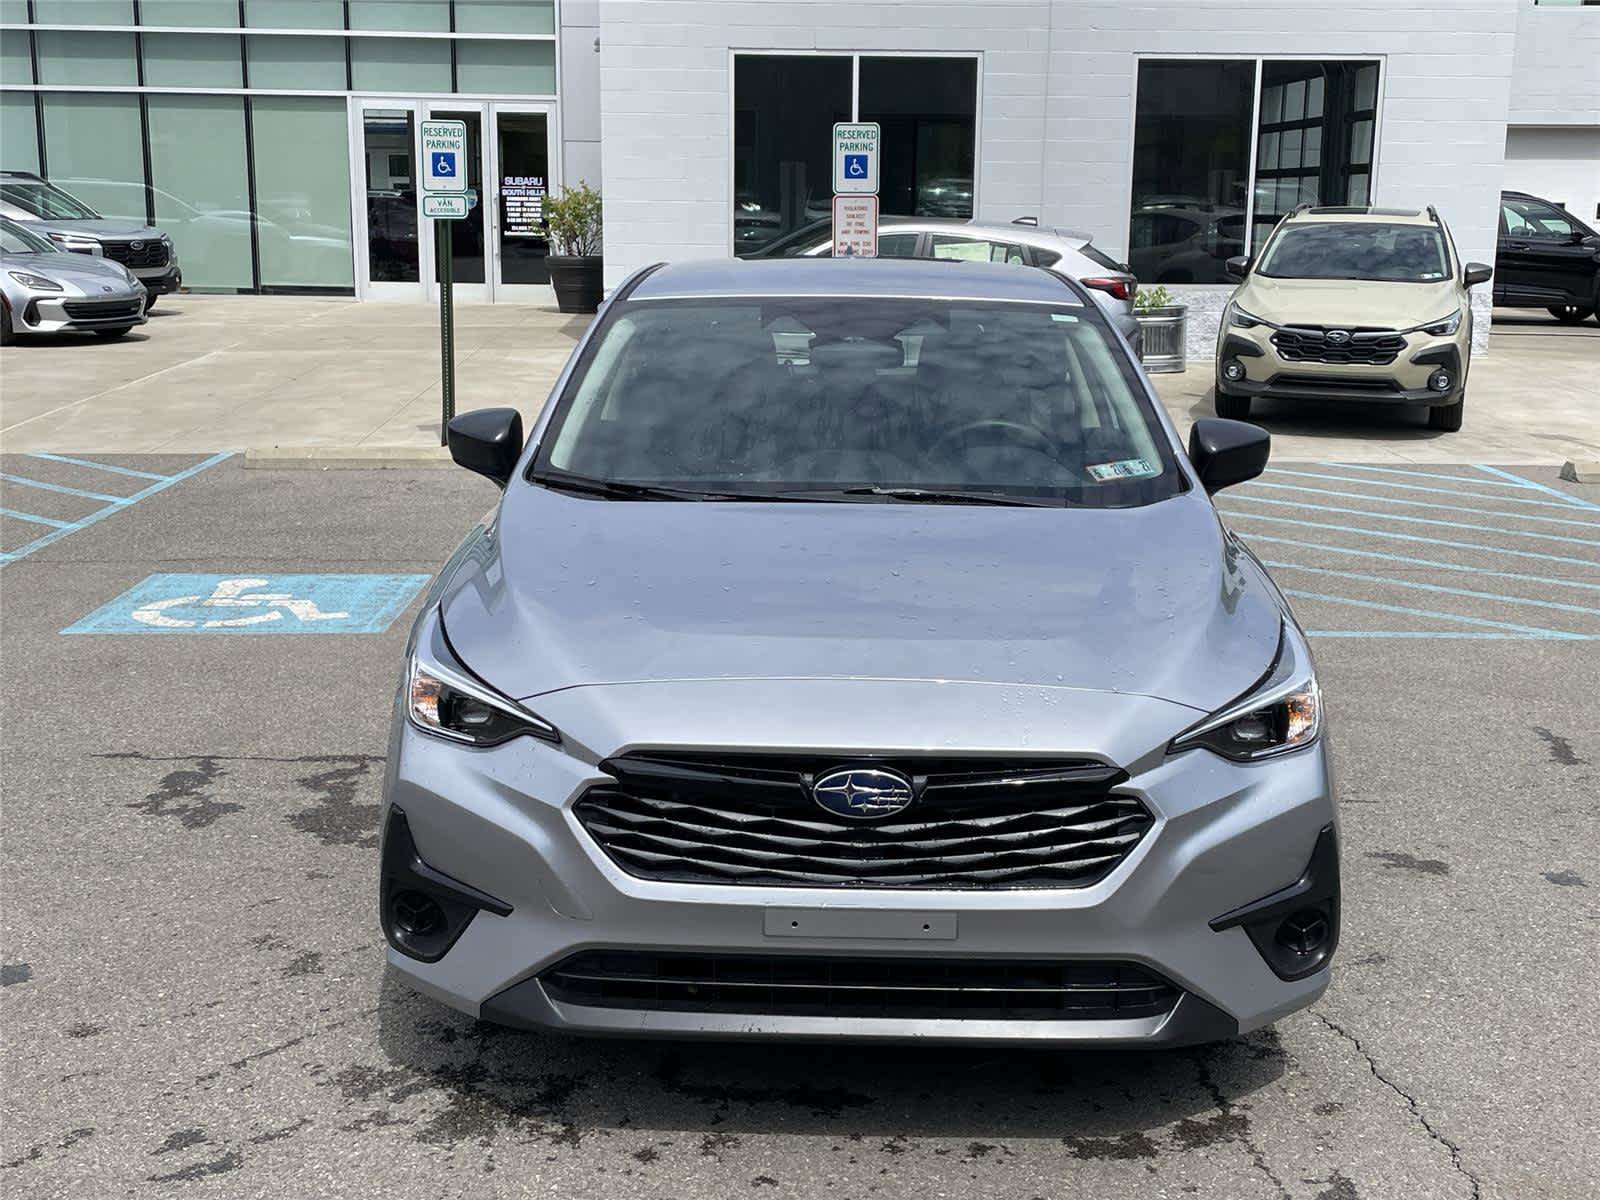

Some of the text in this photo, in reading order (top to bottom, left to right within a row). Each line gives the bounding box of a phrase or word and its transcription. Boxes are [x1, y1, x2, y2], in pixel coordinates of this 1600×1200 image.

[423, 127, 463, 137] RESERVED
[837, 130, 877, 140] RESERVED
[426, 139, 461, 150] PARKING
[839, 142, 874, 152] PARKING
[504, 176, 543, 186] SUBARU
[437, 199, 453, 207] VAN
